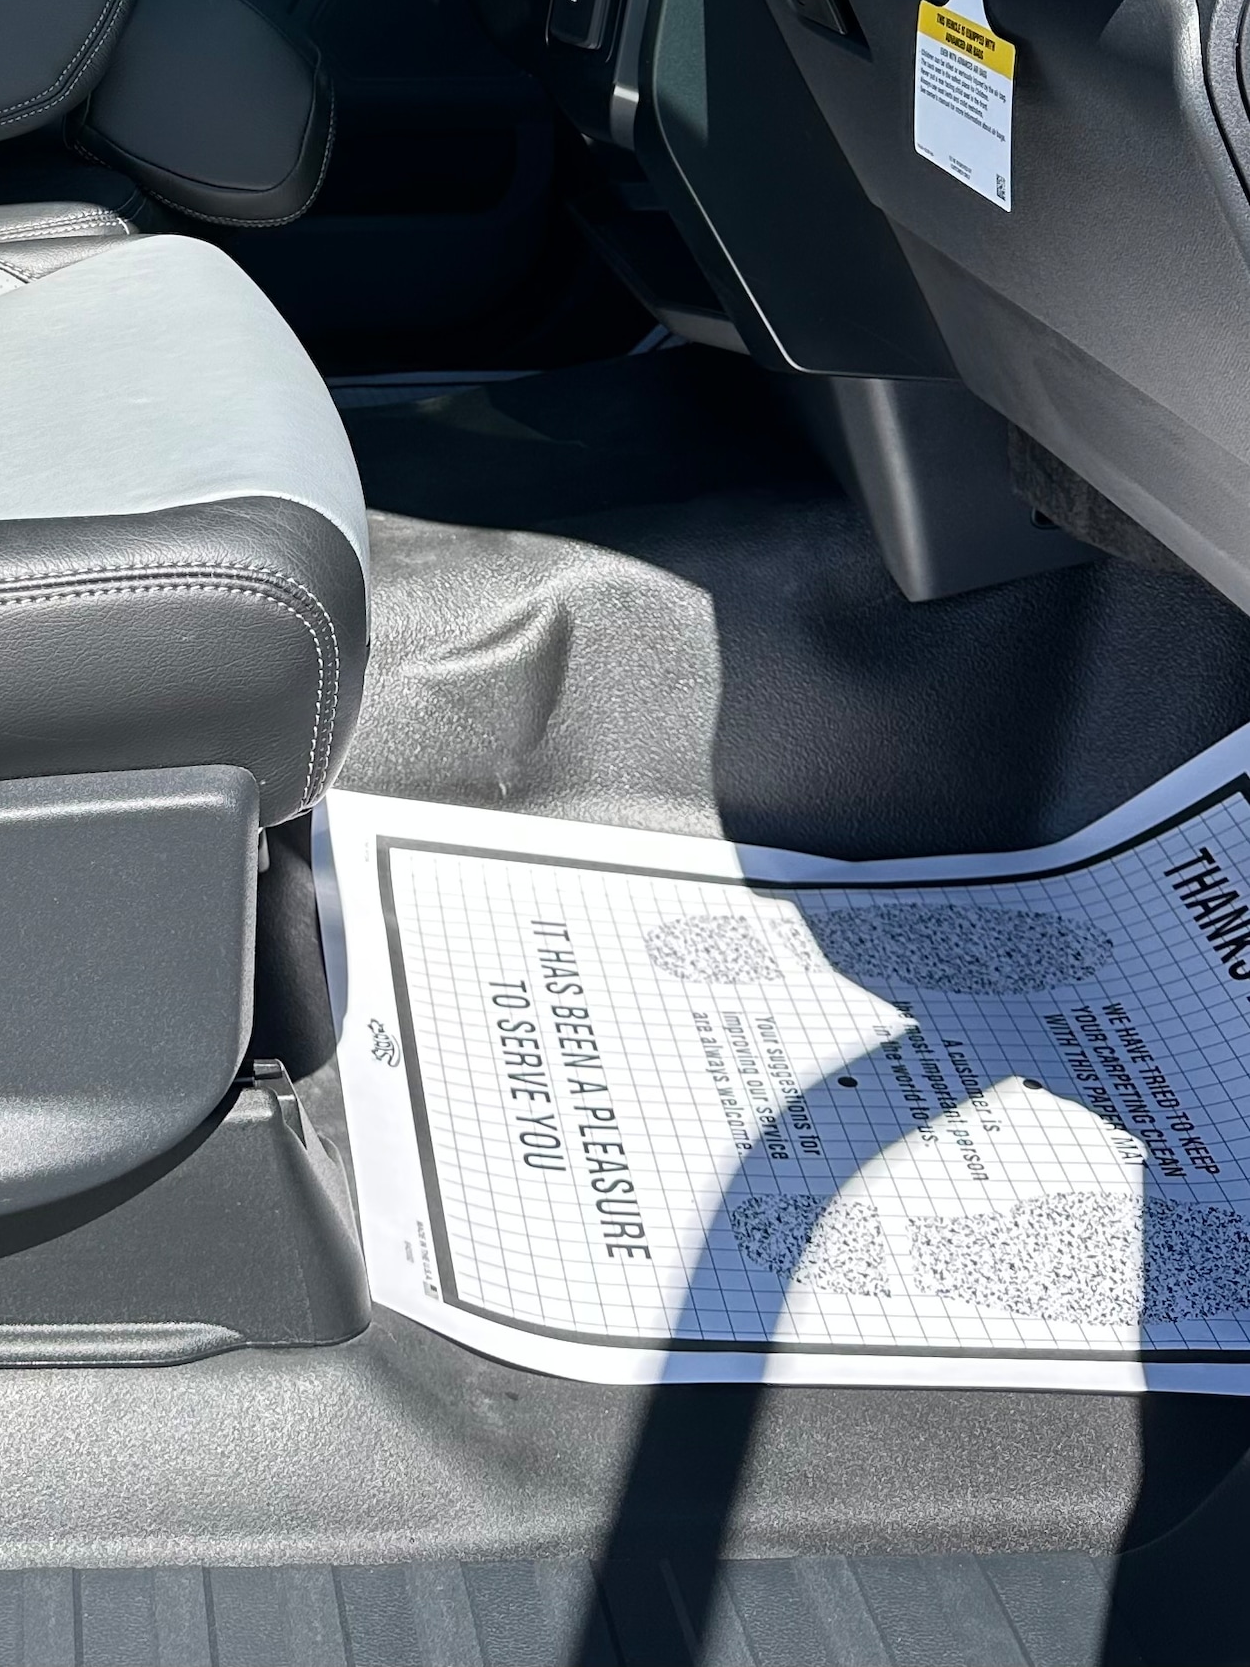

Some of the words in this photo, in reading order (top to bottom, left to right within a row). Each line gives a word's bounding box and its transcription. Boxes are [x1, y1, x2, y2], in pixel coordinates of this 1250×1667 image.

[531, 920, 570, 941] IT
[537, 948, 583, 995] HAS
[489, 980, 530, 1009] TO
[693, 1012, 713, 1032] are
[755, 1016, 779, 1044] Your
[873, 1025, 892, 1036] in
[1102, 1003, 1131, 1025] WE
[551, 1004, 604, 1069] BEEN
[722, 1011, 760, 1075] improving
[880, 1040, 902, 1061] the
[942, 1038, 963, 1048] A
[1115, 1027, 1154, 1064] HAVE
[497, 1018, 551, 1103] SERVE
[700, 1037, 730, 1083] always
[567, 1078, 608, 1094] A
[746, 1079, 768, 1102] our
[766, 1048, 811, 1130] suggestions
[891, 1064, 927, 1102] world
[892, 1000, 914, 1019] the
[905, 1024, 934, 1055] most
[920, 1058, 968, 1123] important
[946, 1128, 989, 1181] person
[949, 1052, 992, 1115] customer
[1043, 1014, 1081, 1046] WITH
[1065, 1050, 1099, 1083] THIS
[1083, 1085, 1127, 1131] PAPER
[1111, 1137, 1149, 1169] MAT
[1071, 1005, 1108, 1042] YOUR
[1093, 1045, 1156, 1124] CARPETING
[1141, 1127, 1187, 1177] CLEAN
[1139, 1065, 1180, 1109] TRIED
[717, 1087, 752, 1156] welcome.
[910, 1106, 930, 1120] to
[981, 1119, 1002, 1133] is
[1166, 1111, 1195, 1132] TO
[516, 1114, 566, 1171] YOU
[756, 1106, 789, 1160] service
[798, 1134, 821, 1156] for
[917, 1124, 939, 1147] us.
[1179, 1136, 1220, 1175] KEEP
[574, 1105, 652, 1260] PLEASURE
